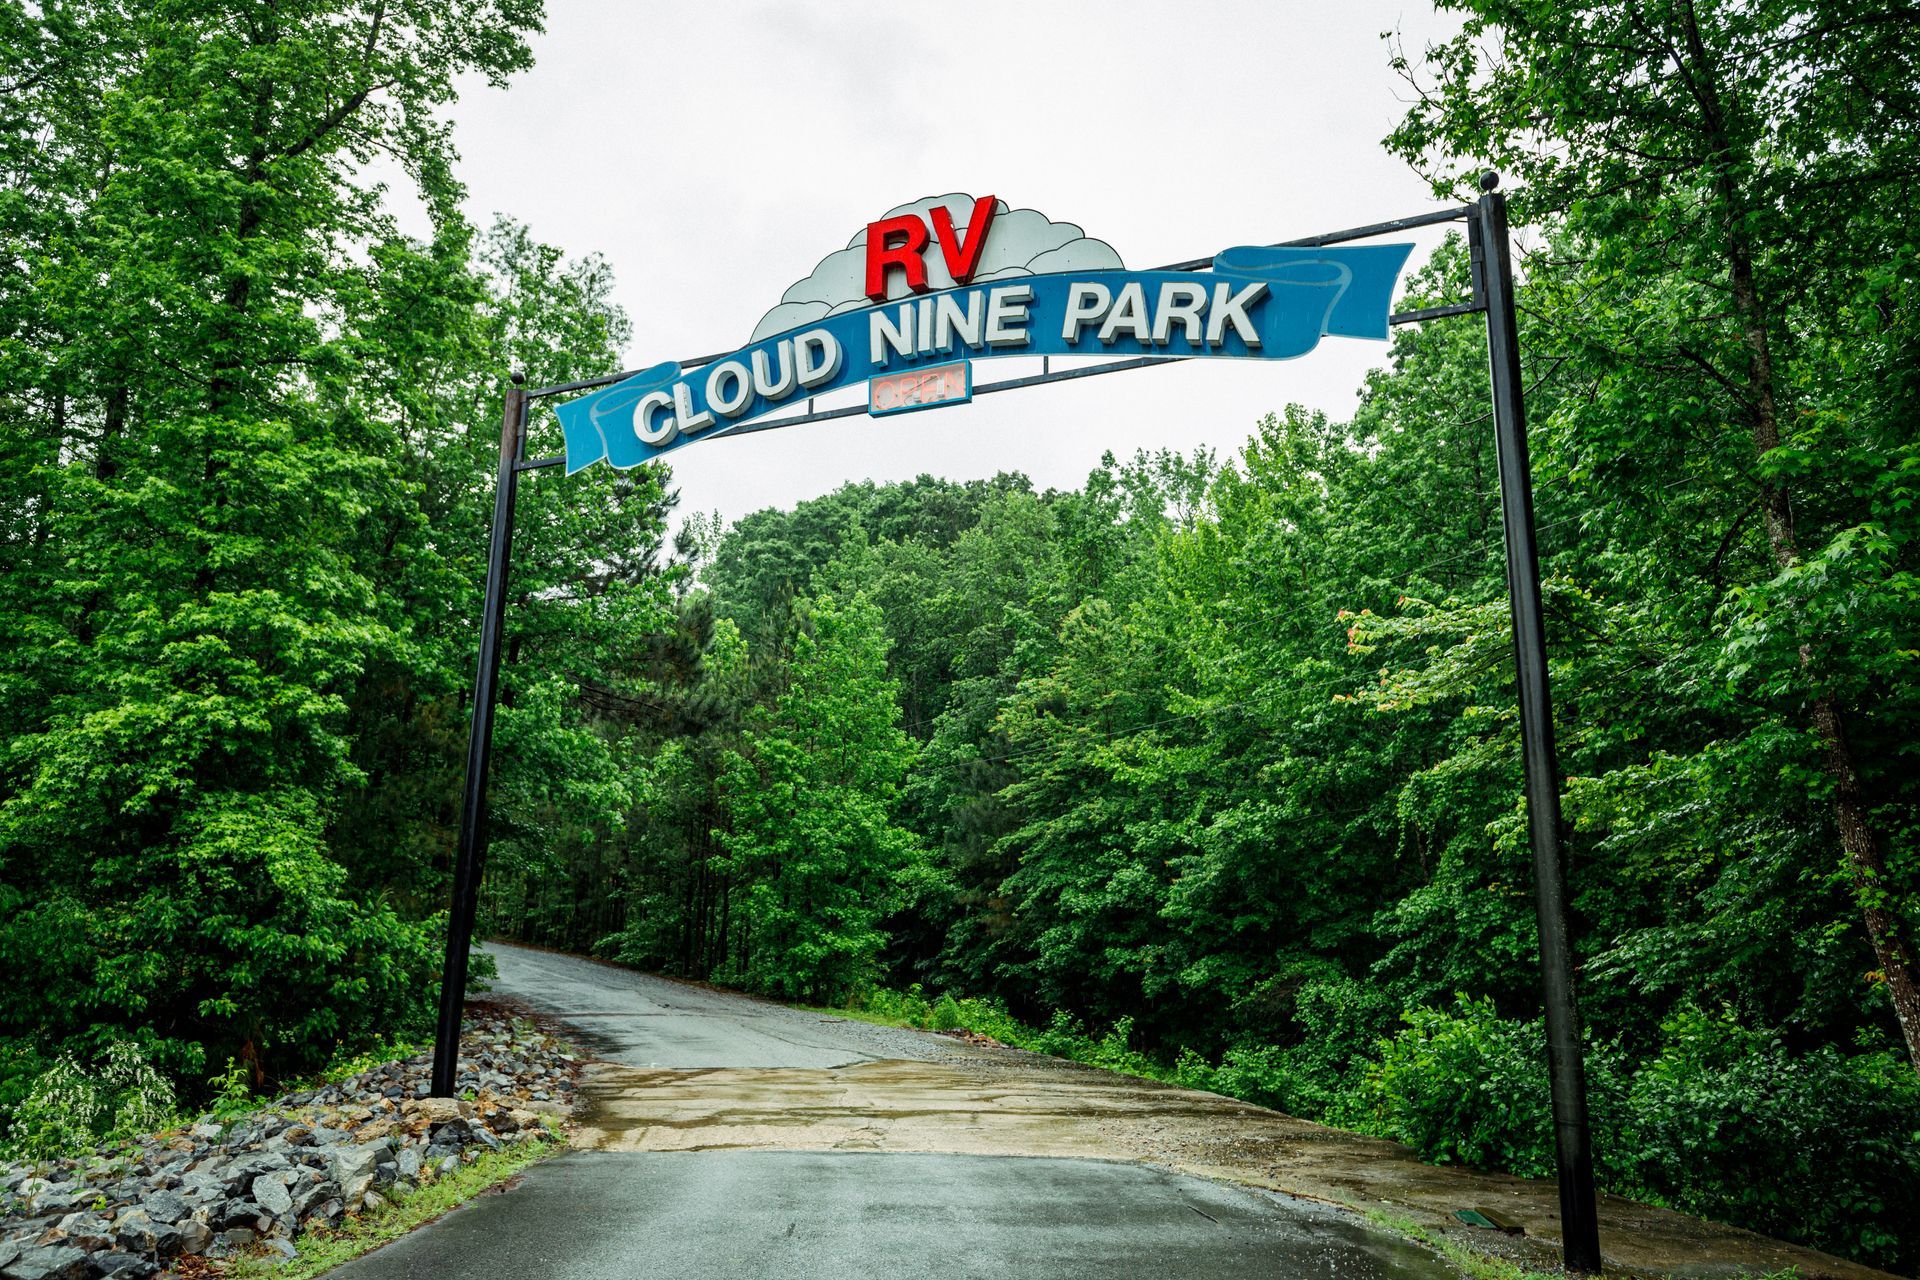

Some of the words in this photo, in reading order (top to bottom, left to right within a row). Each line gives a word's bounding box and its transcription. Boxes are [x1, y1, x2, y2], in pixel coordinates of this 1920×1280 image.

[865, 195, 998, 301] RV
[633, 328, 843, 446] CLOUD
[869, 284, 1034, 367] NINE
[1061, 282, 1268, 347] PARK
[873, 367, 965, 410] OPEN
